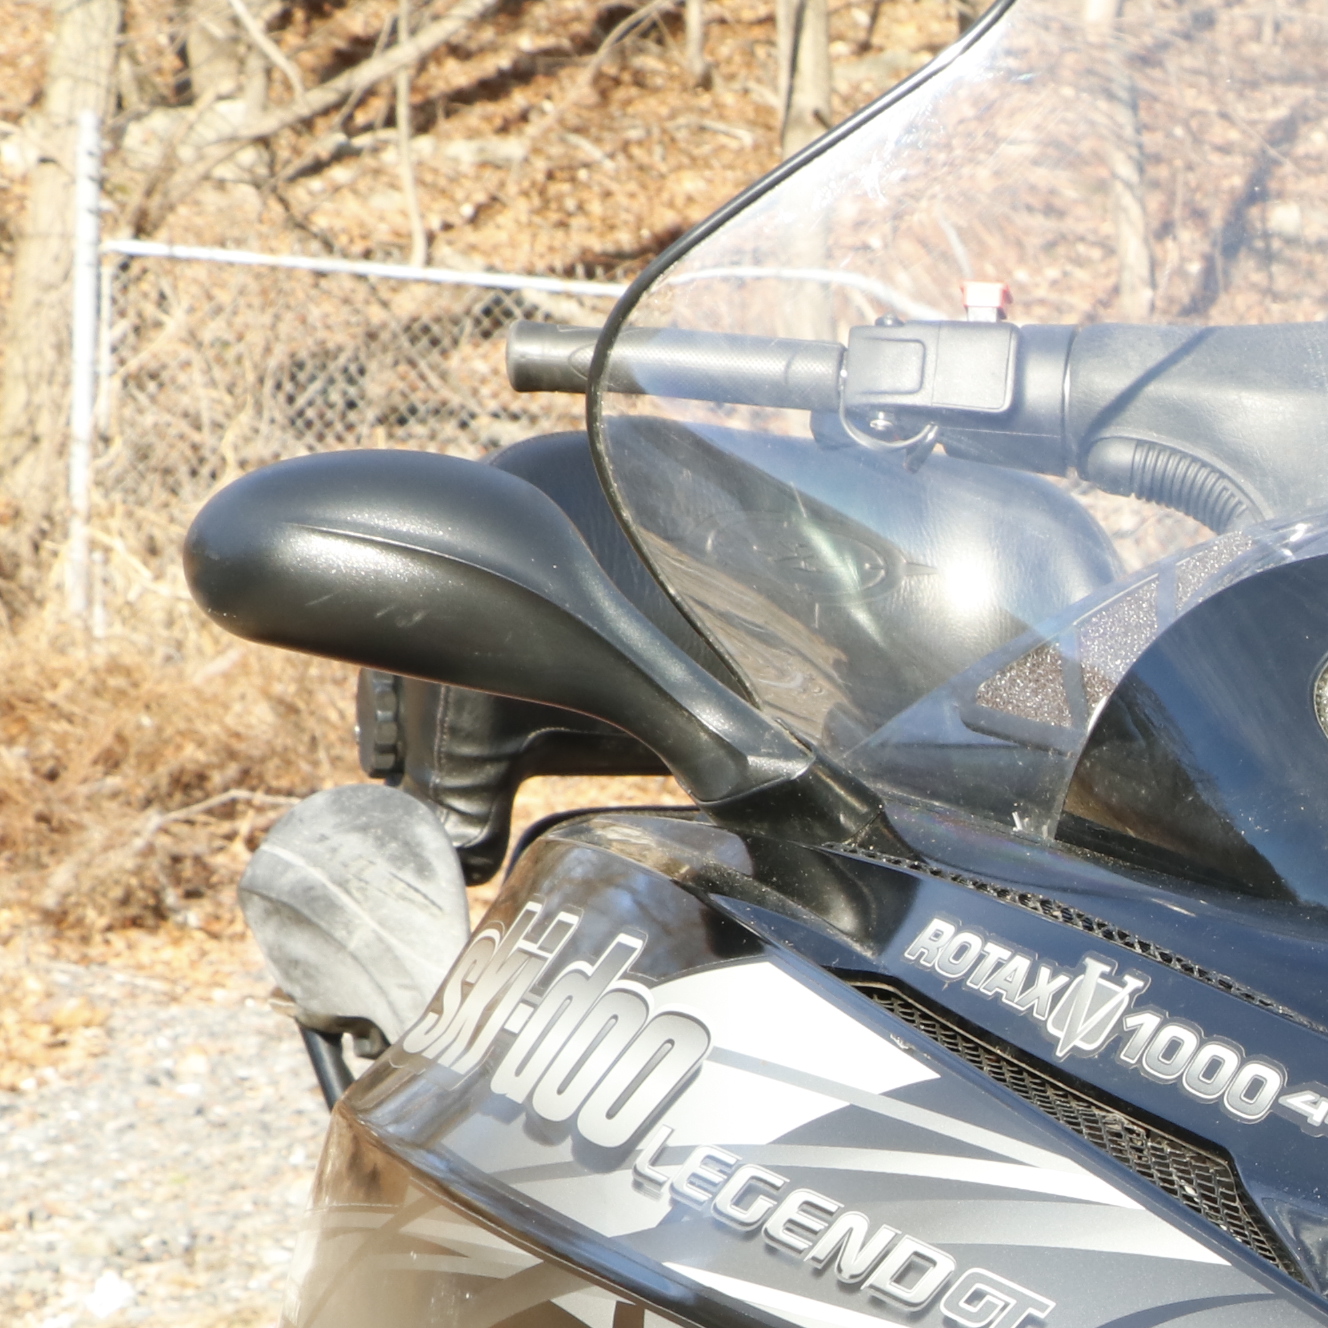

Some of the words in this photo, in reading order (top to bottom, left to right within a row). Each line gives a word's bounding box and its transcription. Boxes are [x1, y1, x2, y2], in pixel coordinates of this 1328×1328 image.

[402, 899, 713, 1148] ski-doo
[904, 918, 1069, 1021] ROTAX
[1120, 1010, 1284, 1121] 1000
[631, 1123, 958, 1313] LEGEND
